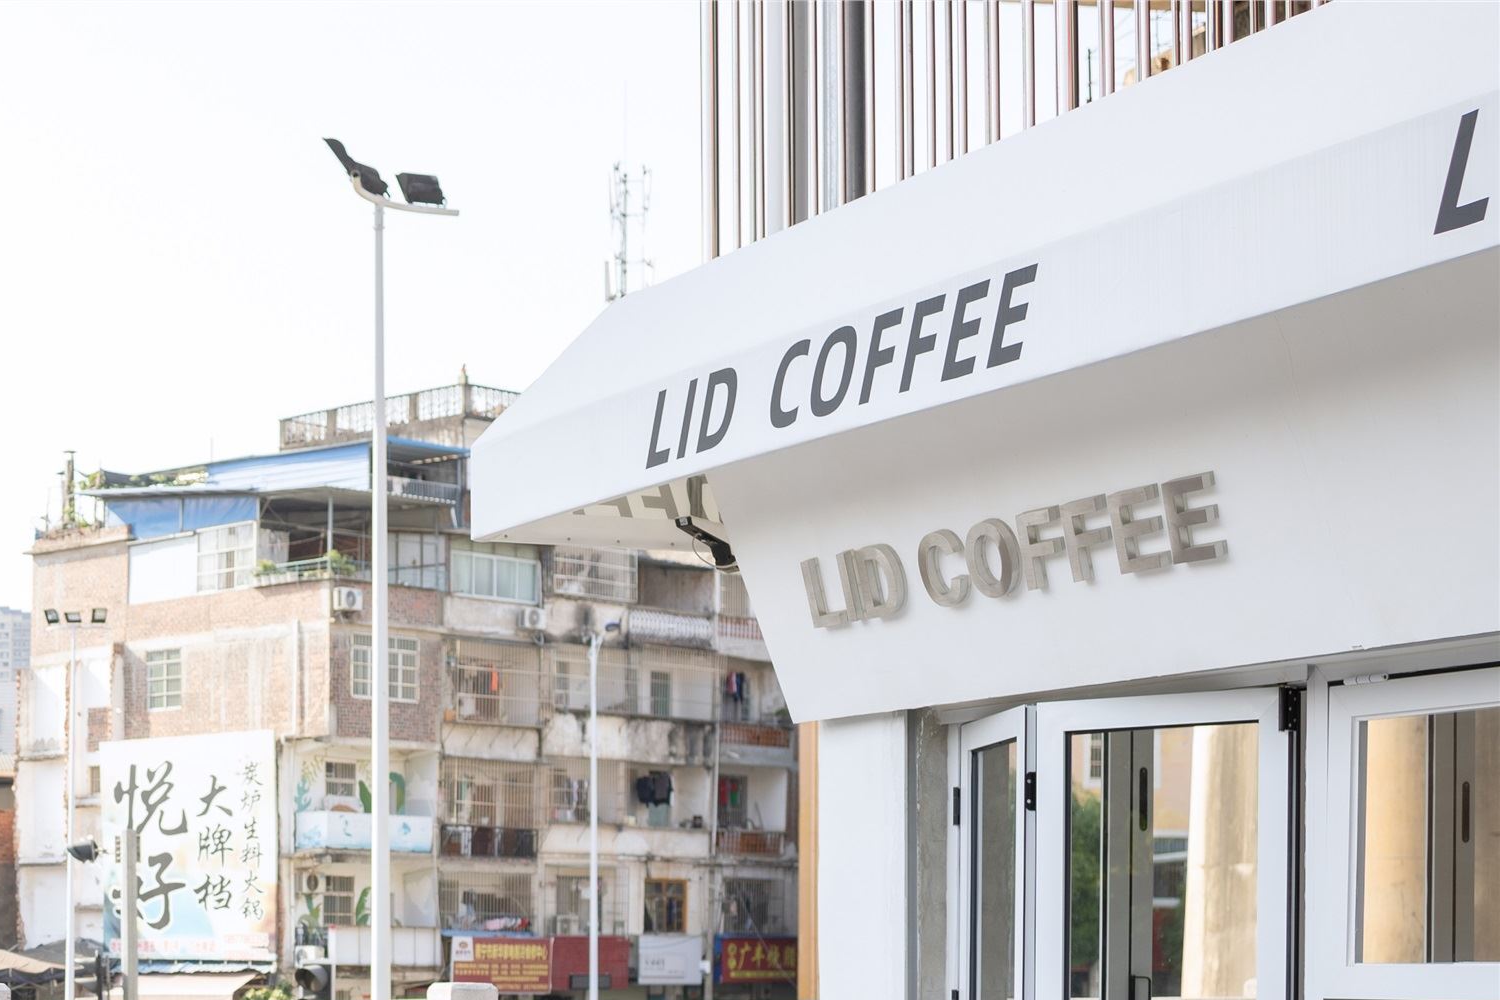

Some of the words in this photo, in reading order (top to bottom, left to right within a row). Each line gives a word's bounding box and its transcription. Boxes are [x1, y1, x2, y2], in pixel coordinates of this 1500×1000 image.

[1432, 108, 1490, 236] L
[645, 366, 738, 470] LID
[769, 262, 1039, 429] COFFEE
[799, 541, 907, 630] LID
[917, 469, 1229, 608] COFFEE
[193, 774, 235, 912] 大牌档
